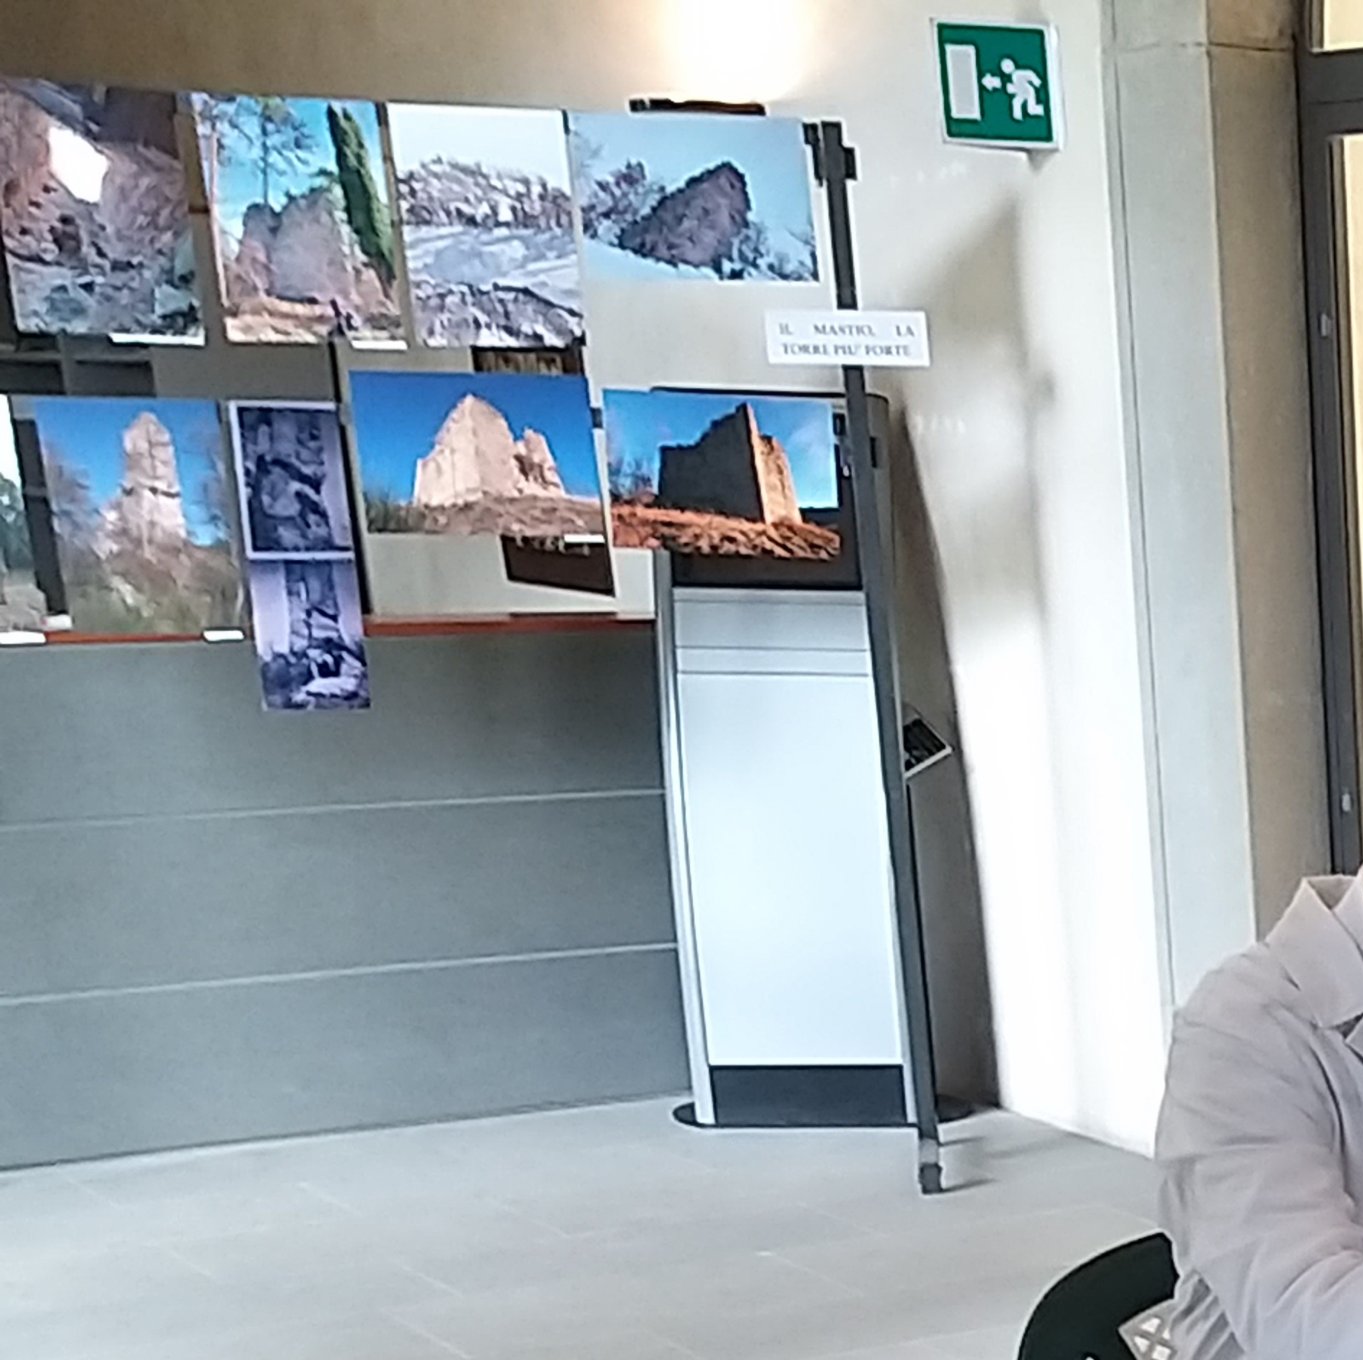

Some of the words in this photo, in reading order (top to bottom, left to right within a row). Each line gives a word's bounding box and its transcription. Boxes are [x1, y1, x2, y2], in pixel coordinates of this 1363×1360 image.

[778, 323, 793, 336] IL
[895, 325, 915, 338] LA
[782, 342, 829, 356] TORRE
[865, 345, 911, 357] FORTE
